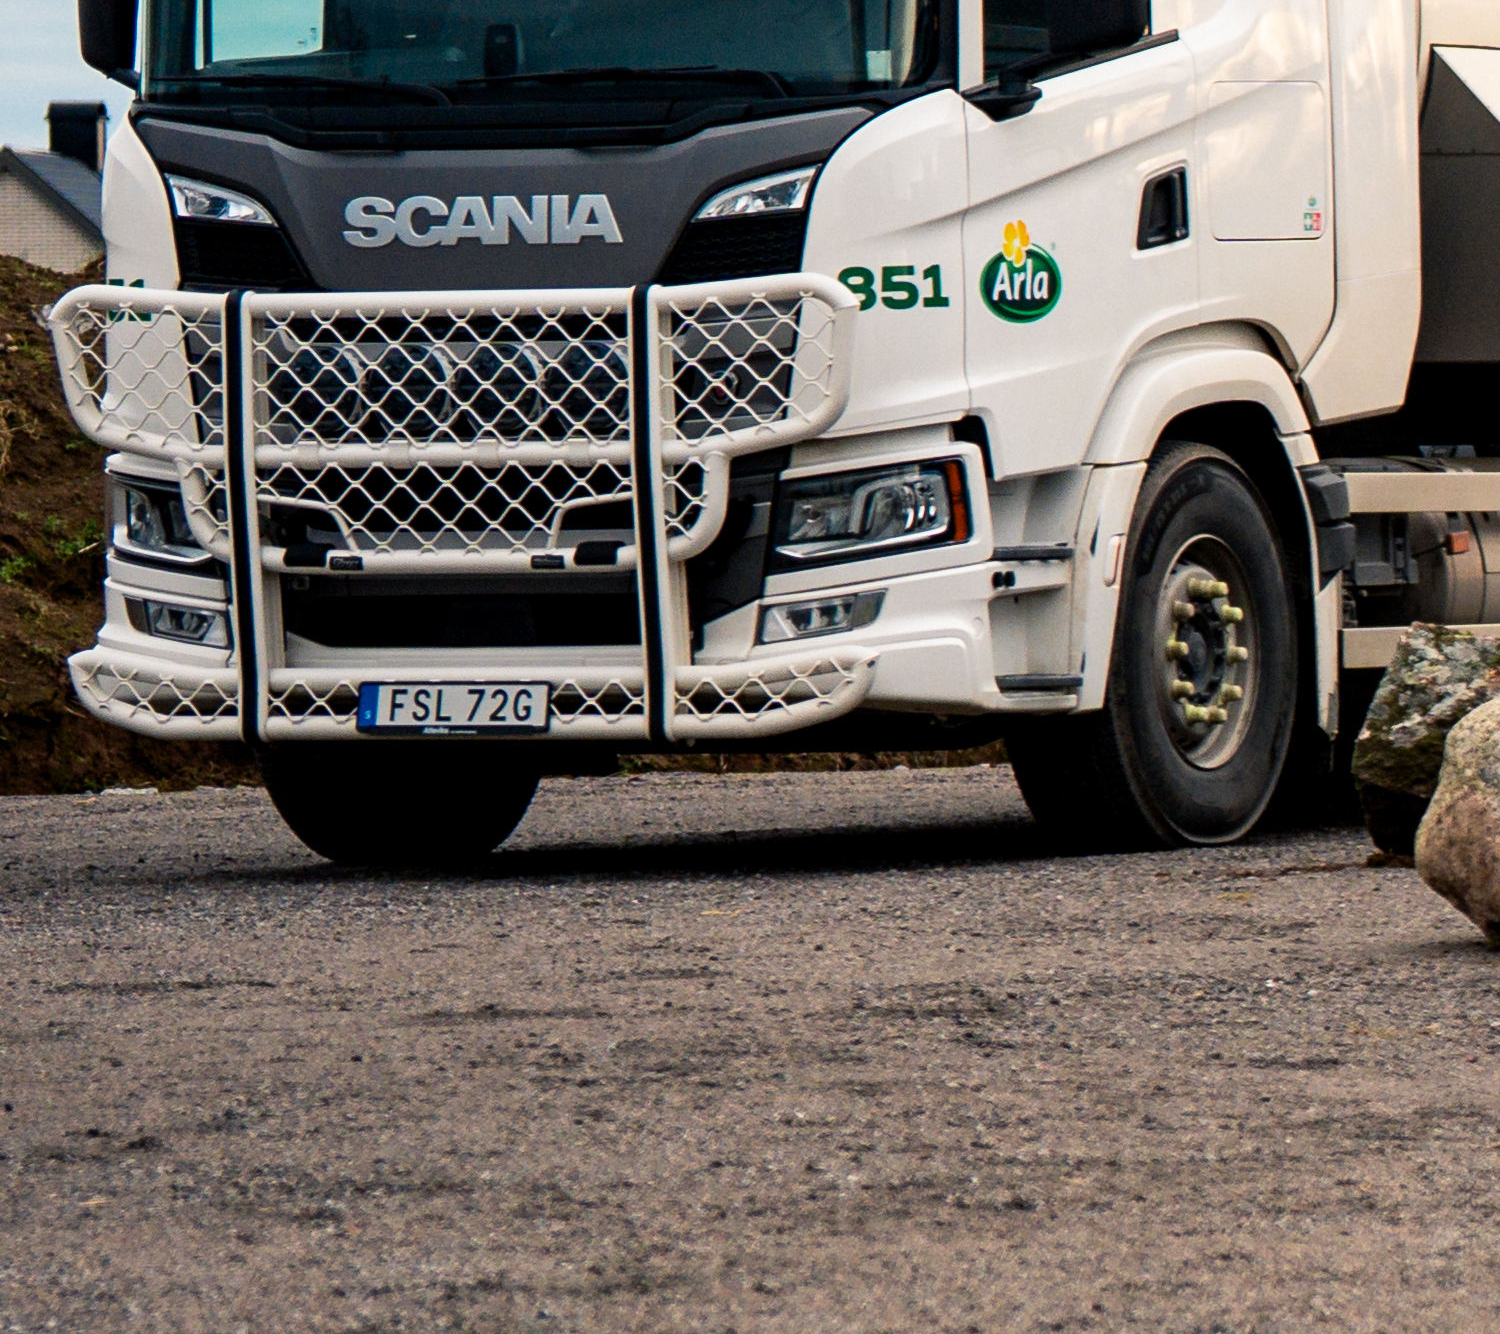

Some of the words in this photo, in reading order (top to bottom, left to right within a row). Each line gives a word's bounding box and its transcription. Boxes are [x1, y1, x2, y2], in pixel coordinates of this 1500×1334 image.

[342, 194, 624, 248] SCANIA
[837, 264, 950, 312] 851
[992, 259, 1049, 301] Arla
[389, 688, 452, 722] FSL
[467, 688, 533, 722] 72G
